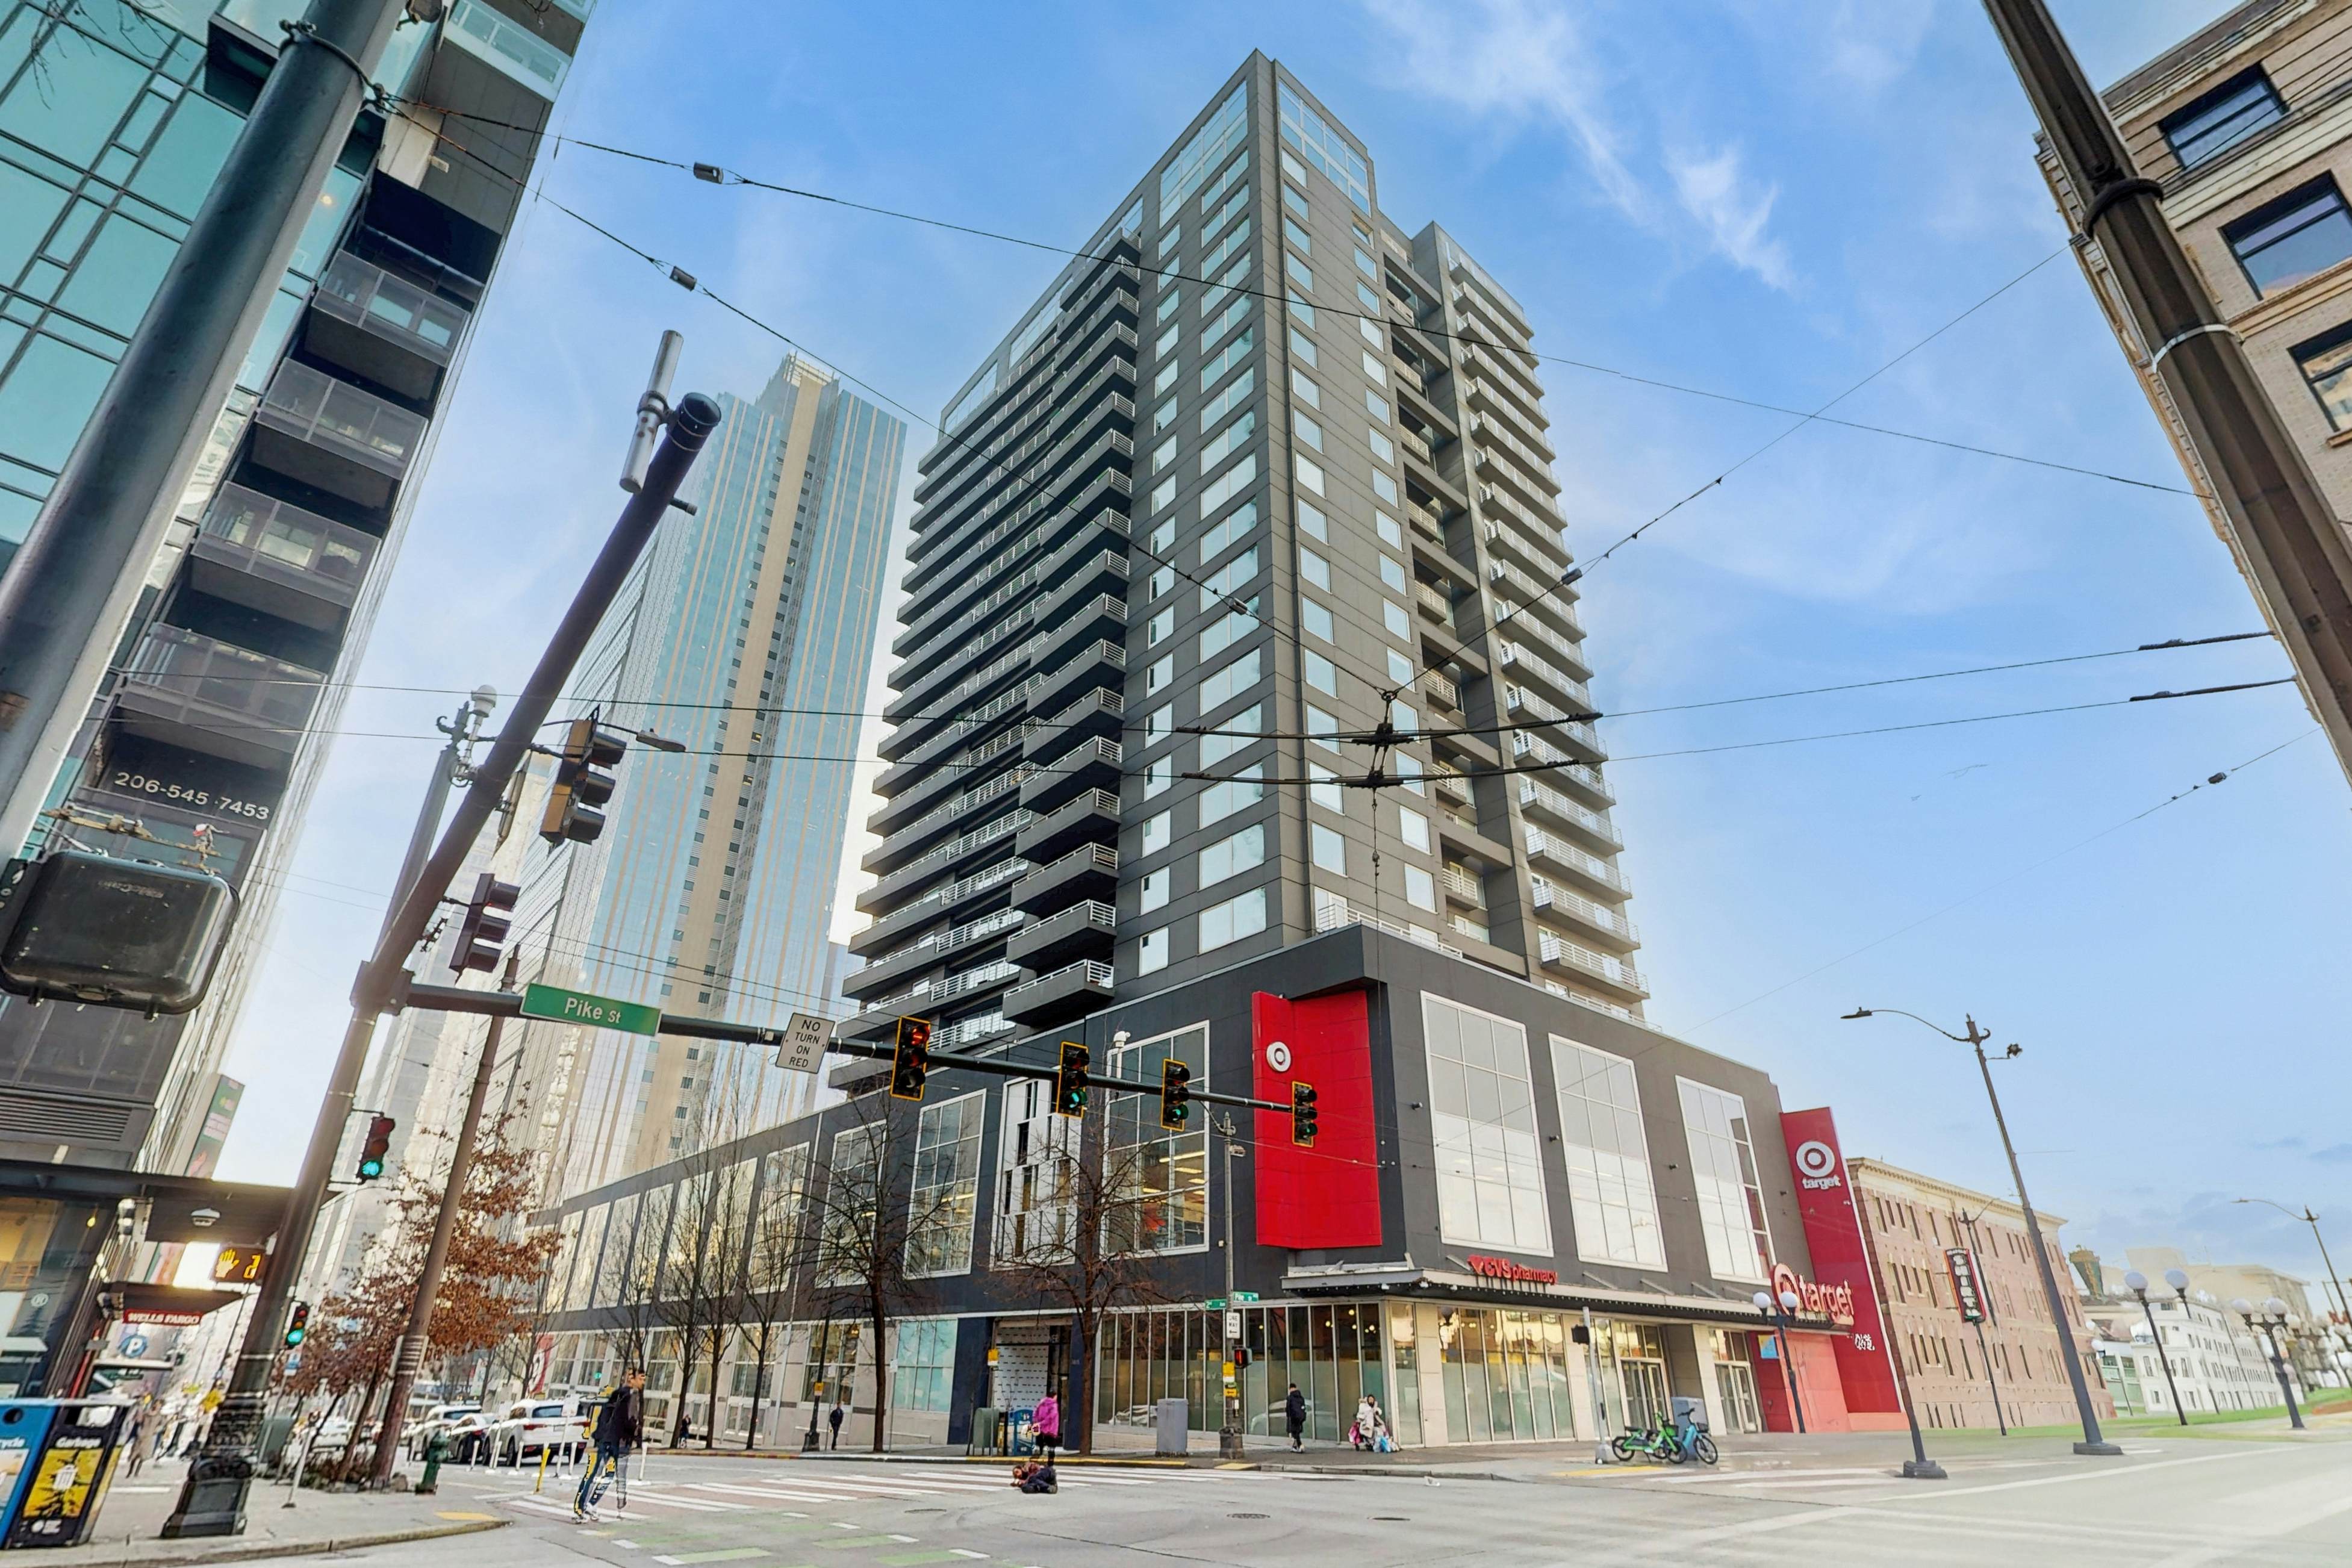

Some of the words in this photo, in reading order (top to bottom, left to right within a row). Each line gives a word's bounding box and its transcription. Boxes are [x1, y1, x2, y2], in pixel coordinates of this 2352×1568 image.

[564, 997, 603, 1020] Pike
[608, 1010, 621, 1024] St
[801, 1019, 821, 1032] NO
[795, 1031, 820, 1045] TURN
[797, 1045, 810, 1056] ON
[789, 1056, 809, 1068] RED
[1802, 1174, 1841, 1190] target
[1482, 1257, 1512, 1279] CVS
[1512, 1263, 1558, 1285] pharmacy
[1796, 1274, 1855, 1322] target
[128, 1312, 165, 1323] WELLS
[163, 1313, 201, 1324] FARGO
